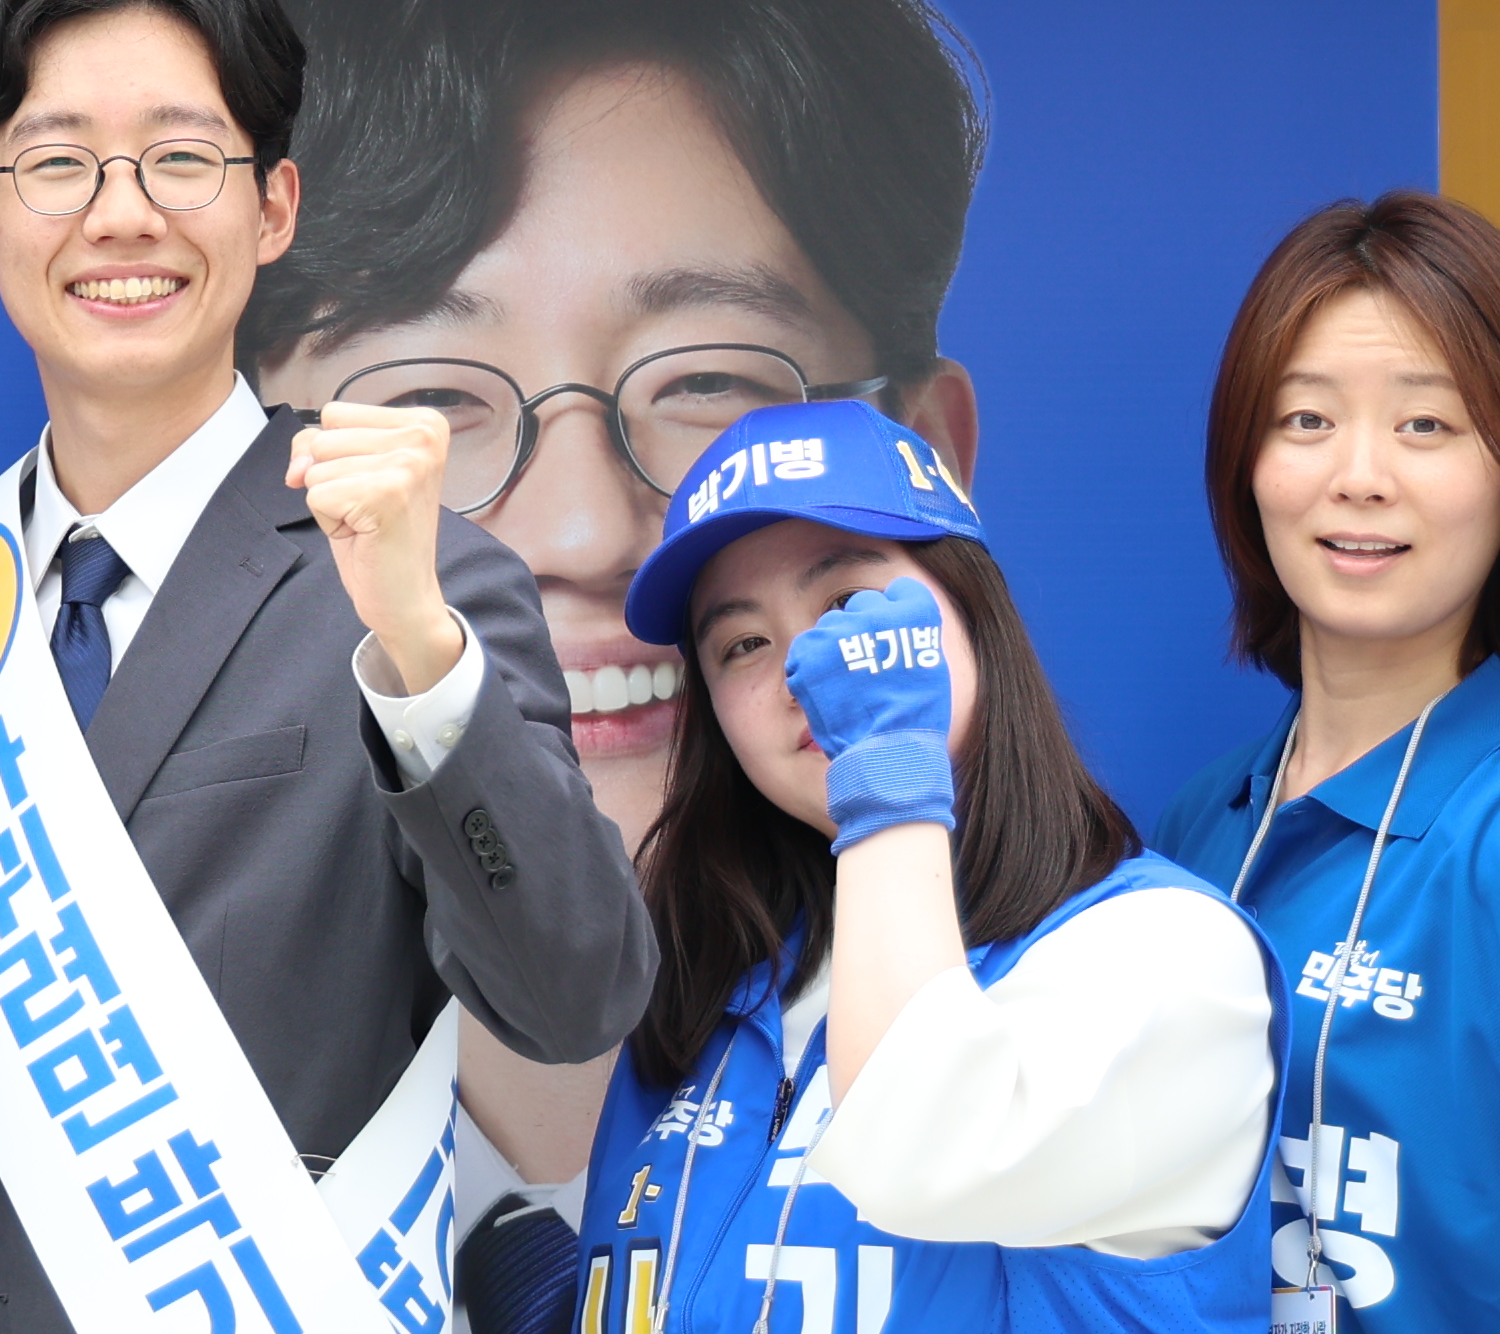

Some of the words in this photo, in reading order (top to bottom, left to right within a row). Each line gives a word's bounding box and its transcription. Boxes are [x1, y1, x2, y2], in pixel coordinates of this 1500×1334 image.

[687, 437, 826, 525] 박기병
[837, 625, 942, 675] 박기병
[1294, 950, 1423, 1020] 민주당
[640, 1099, 735, 1147] 주당
